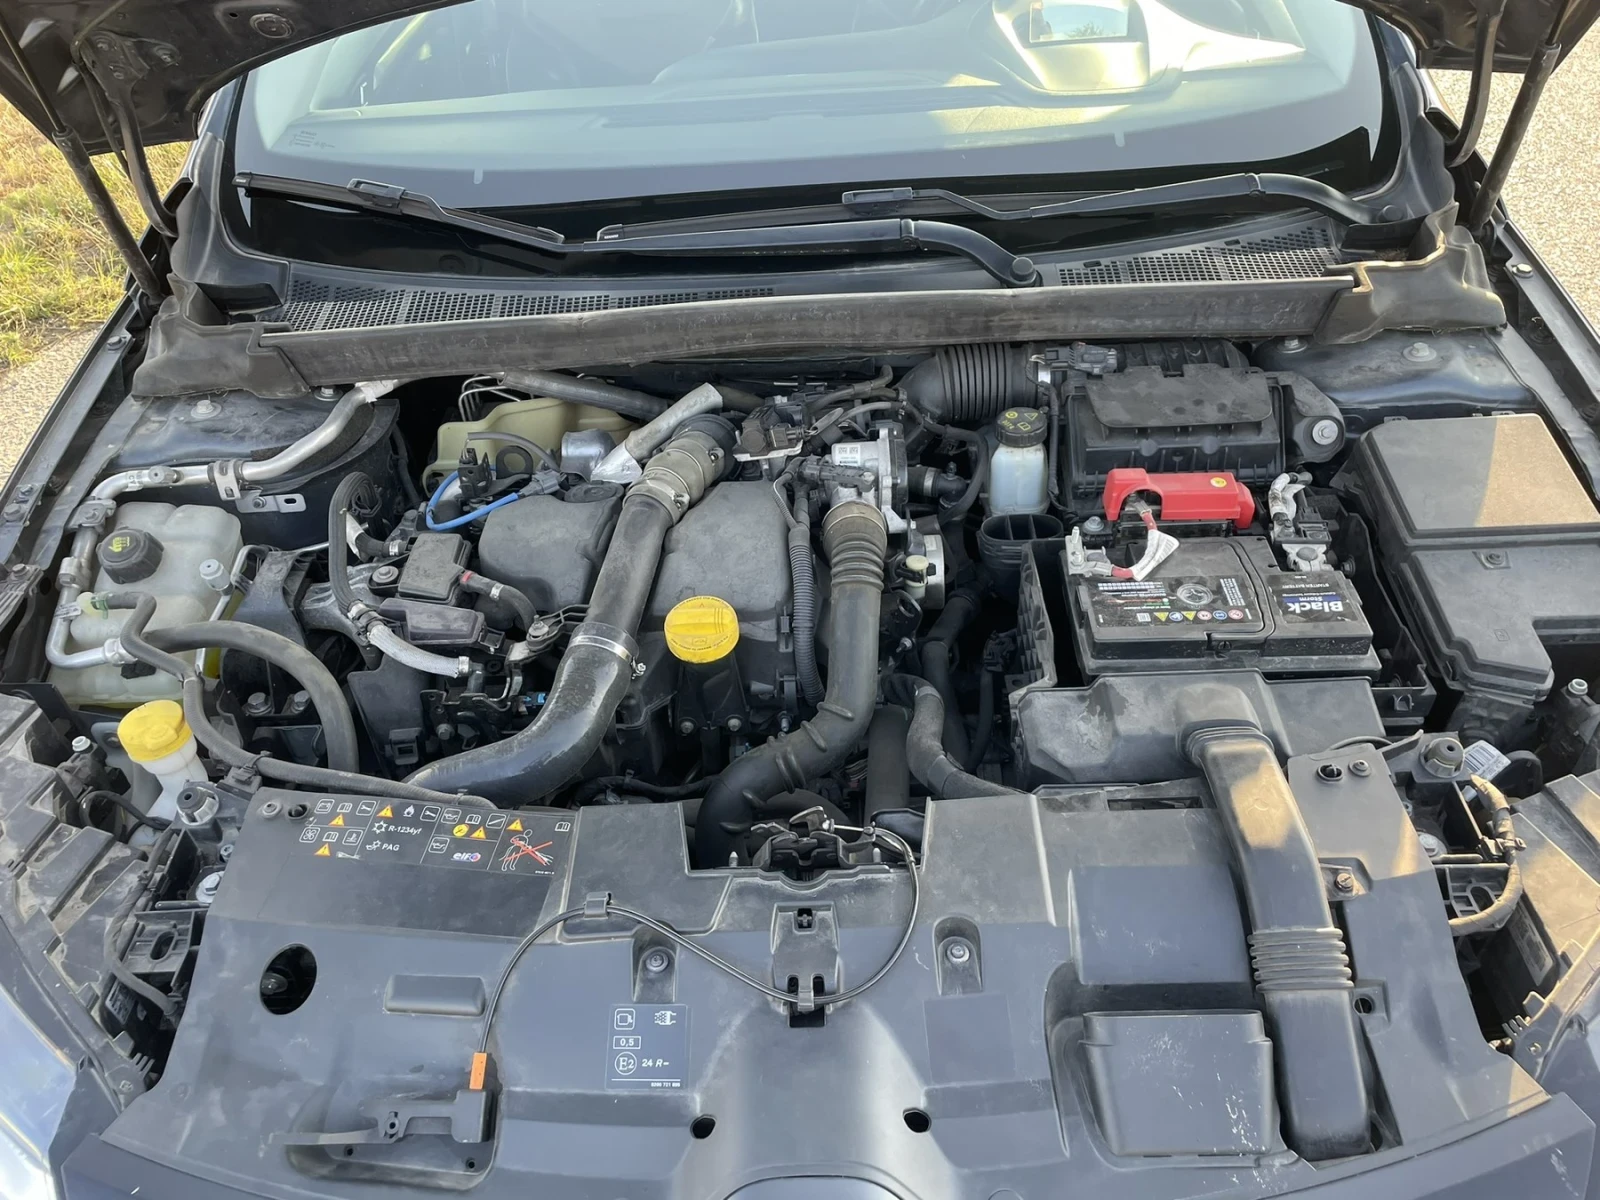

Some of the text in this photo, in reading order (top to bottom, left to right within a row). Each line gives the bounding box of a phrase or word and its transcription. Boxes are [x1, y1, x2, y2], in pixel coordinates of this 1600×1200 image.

[1287, 601, 1343, 613] Black
[388, 826, 422, 835] R-1234yf
[382, 843, 400, 851] PAG
[620, 1038, 634, 1047] 0,5
[619, 1057, 635, 1070] E2
[642, 1059, 653, 1067] 24
